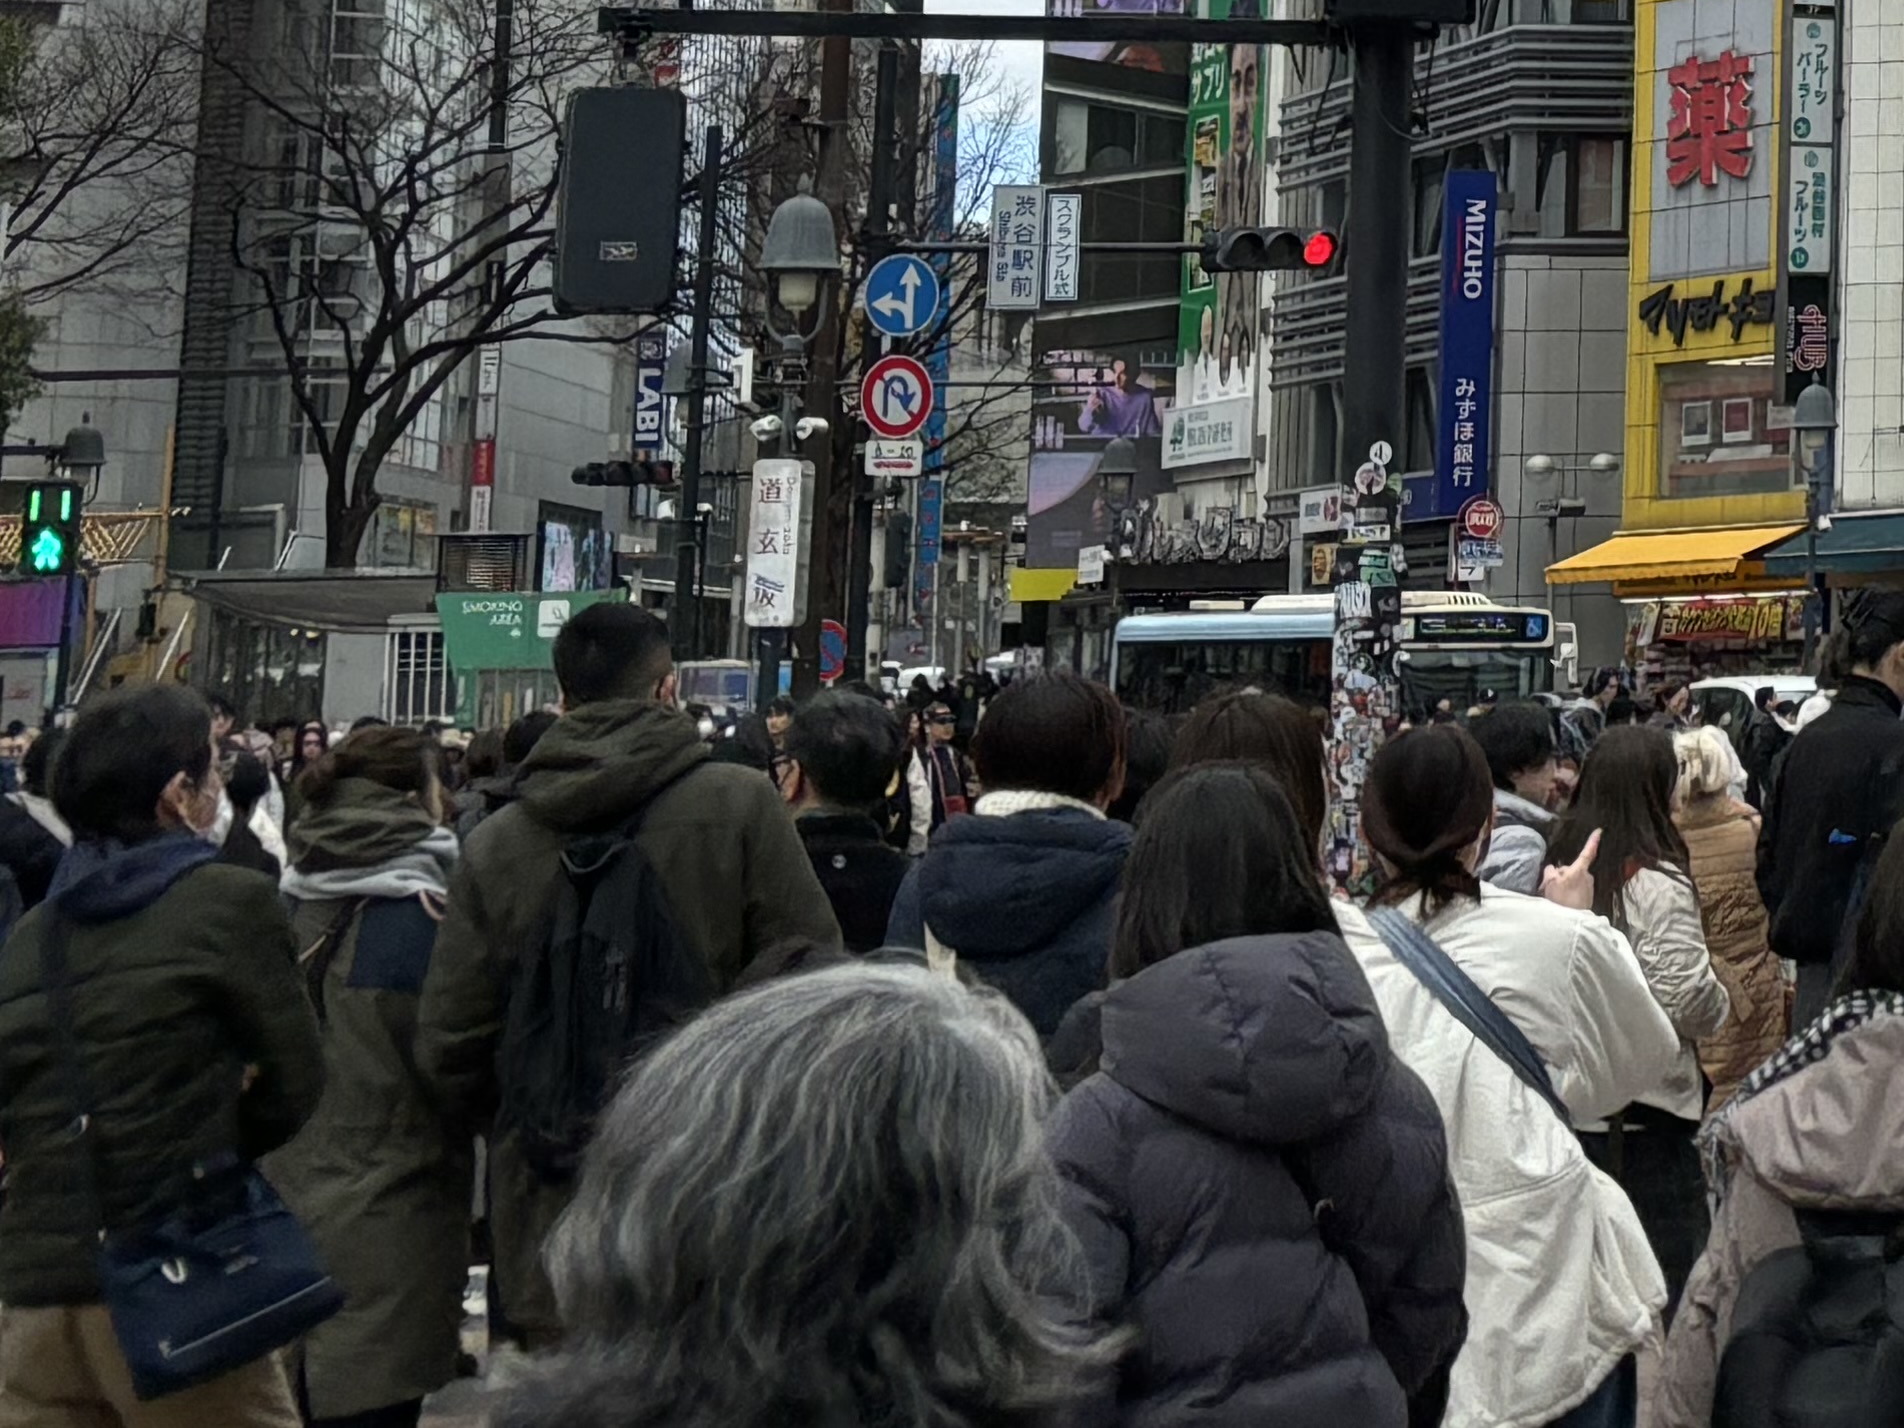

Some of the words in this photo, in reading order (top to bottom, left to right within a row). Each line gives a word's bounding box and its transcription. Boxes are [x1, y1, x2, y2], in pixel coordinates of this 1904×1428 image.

[1666, 49, 1757, 191] 薬
[1010, 194, 1037, 298] 渋谷駅前
[1462, 198, 1487, 299] MIZUHO
[1794, 303, 1828, 372] HUB
[1453, 377, 1477, 487] みずほ銀行
